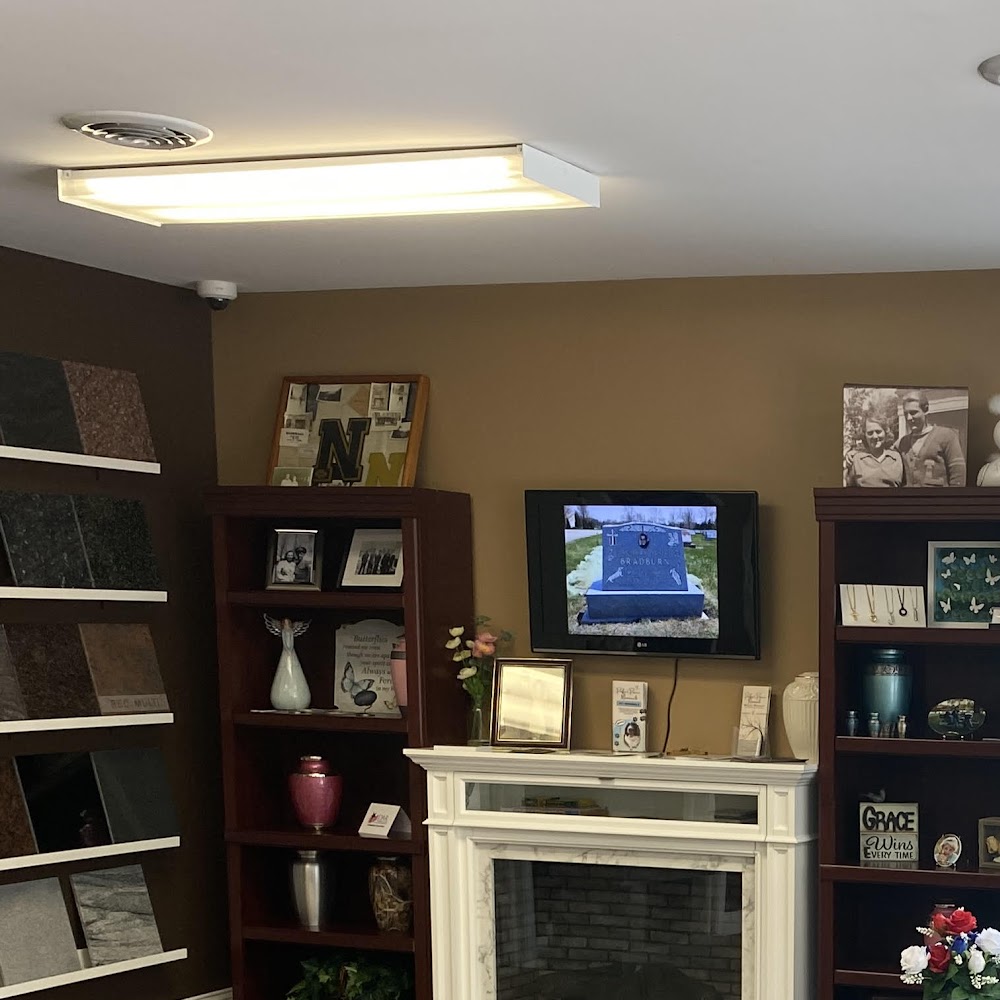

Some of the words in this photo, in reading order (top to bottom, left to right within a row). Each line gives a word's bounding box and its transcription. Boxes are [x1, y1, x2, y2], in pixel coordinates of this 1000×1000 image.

[862, 806, 915, 832] GRACE
[866, 836, 914, 851] Wins
[863, 847, 892, 859] EVERY
[895, 851, 914, 860] TIME
